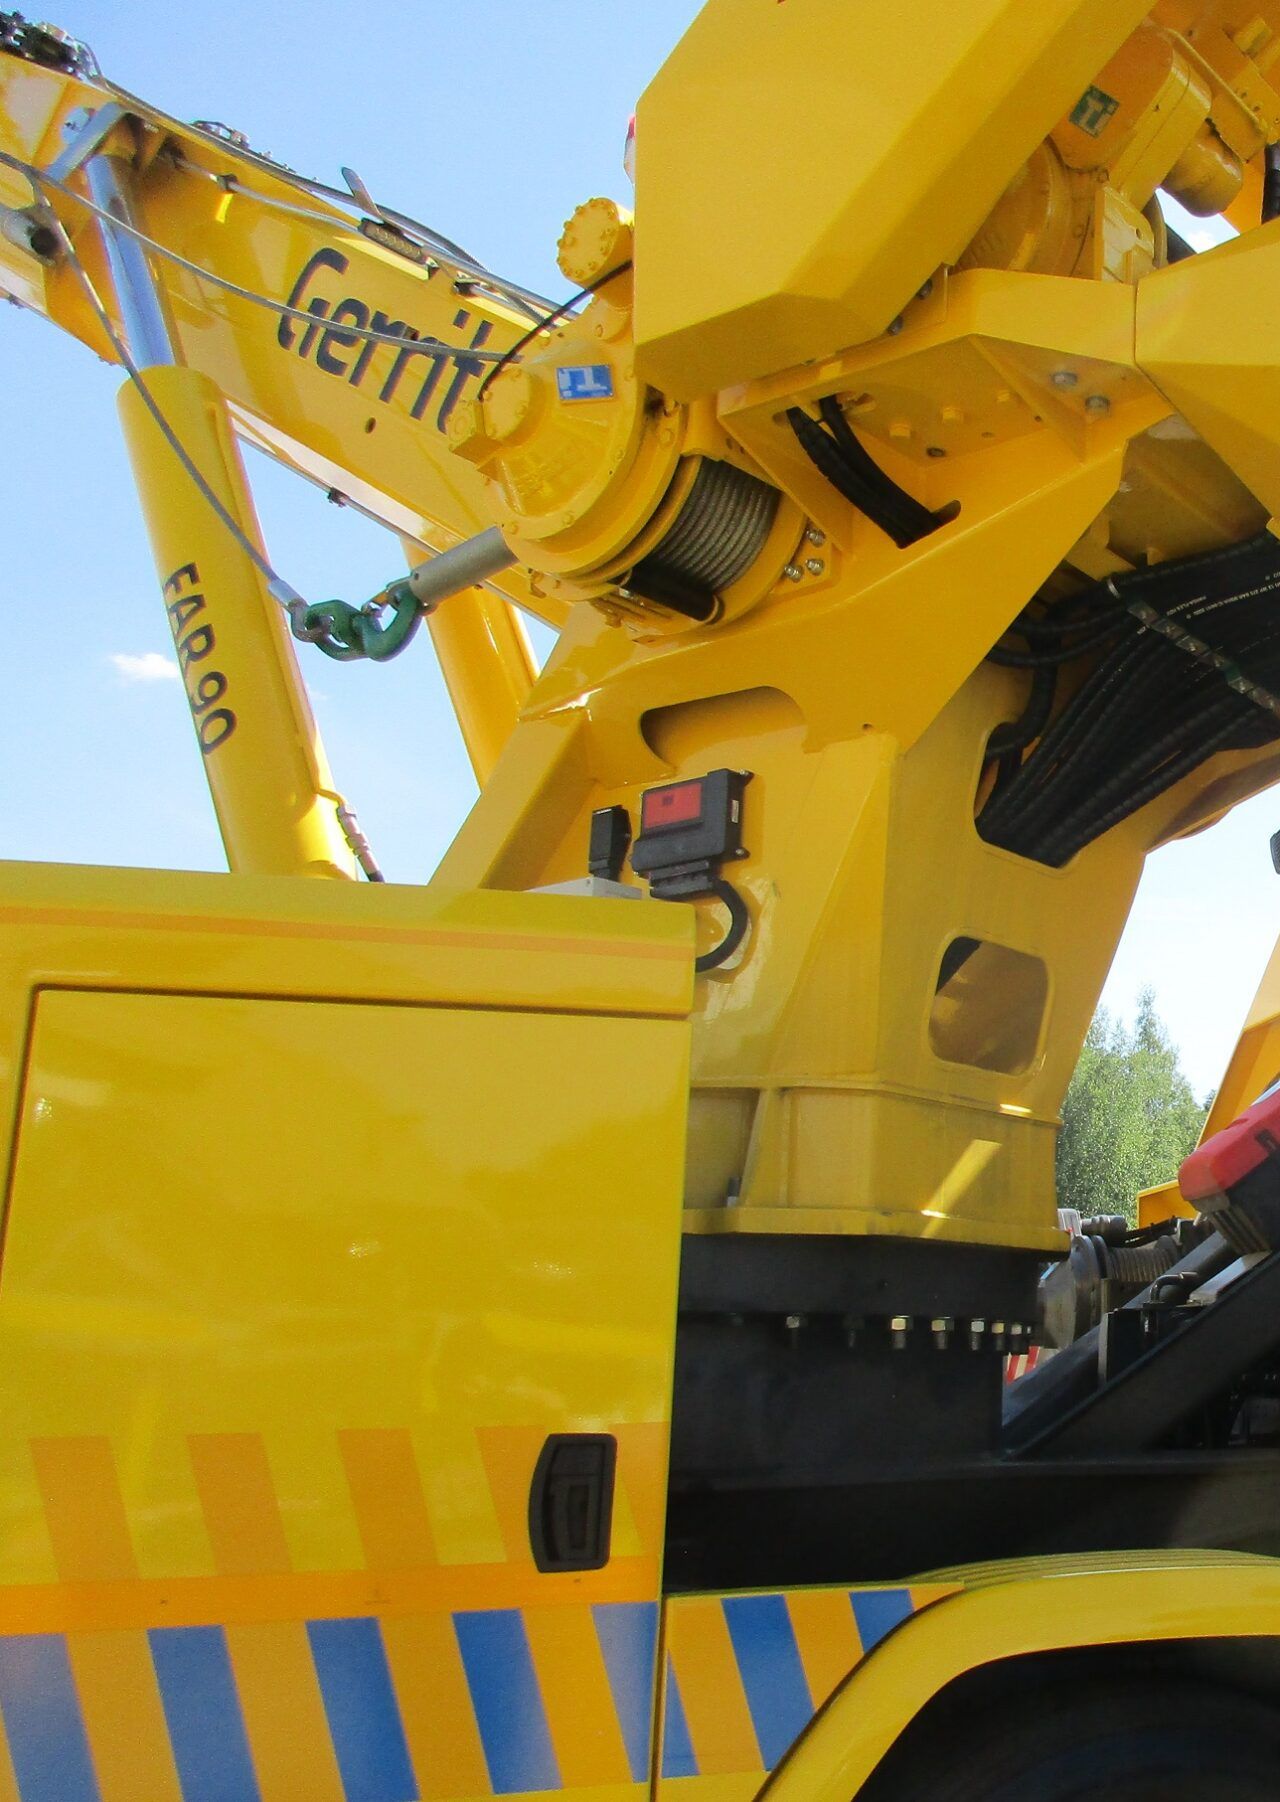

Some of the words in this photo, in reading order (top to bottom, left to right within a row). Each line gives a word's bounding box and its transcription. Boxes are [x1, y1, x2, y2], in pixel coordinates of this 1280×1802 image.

[277, 247, 494, 435] Gerrit
[162, 562, 217, 681] FAR
[187, 671, 238, 755] 90
